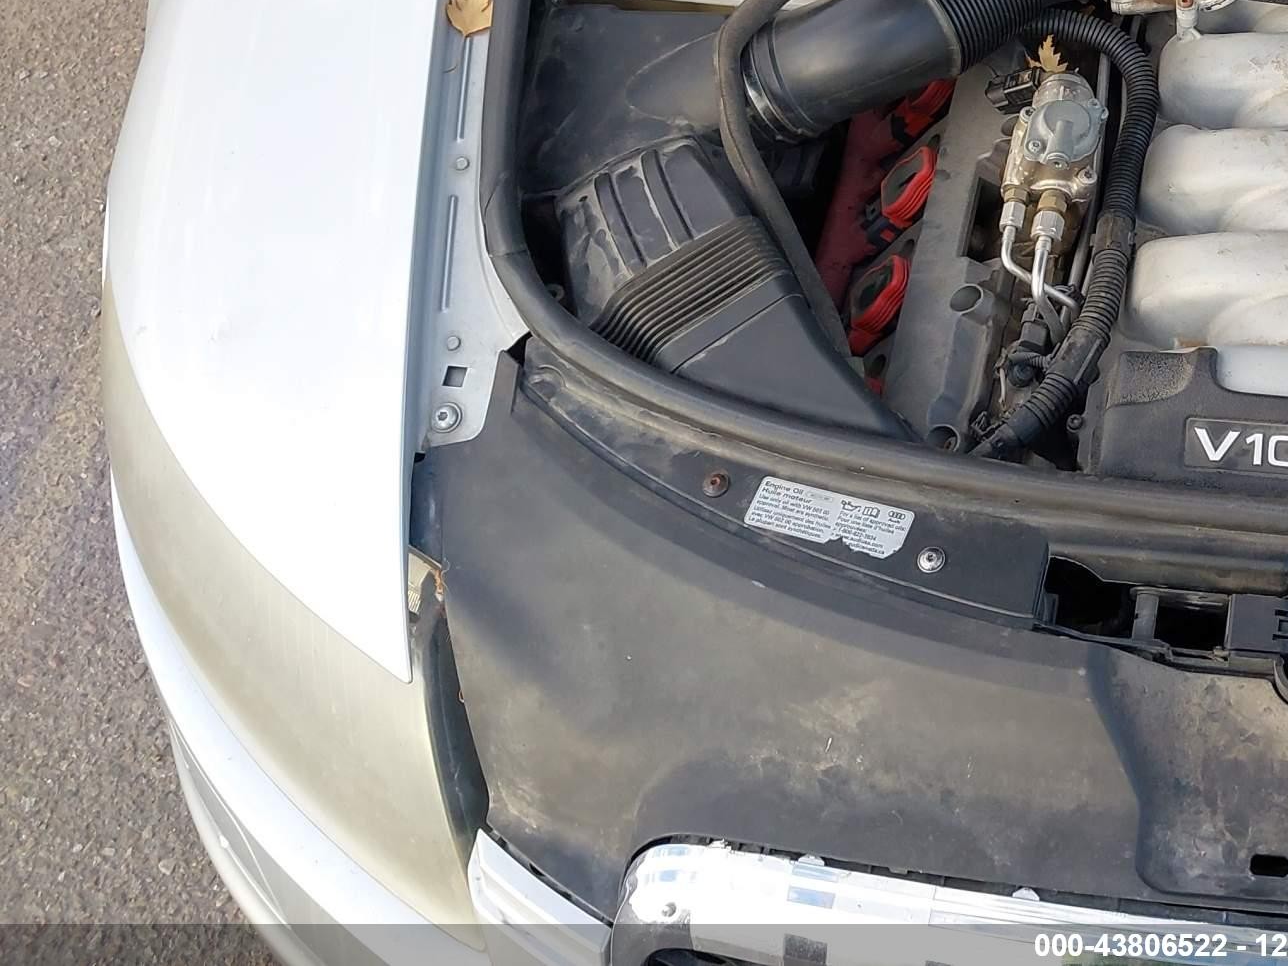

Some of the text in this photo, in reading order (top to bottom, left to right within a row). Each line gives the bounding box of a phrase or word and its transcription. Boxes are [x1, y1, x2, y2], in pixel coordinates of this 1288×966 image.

[765, 481, 790, 491] Engine
[762, 487, 781, 495] Huile
[783, 493, 813, 503] moteur
